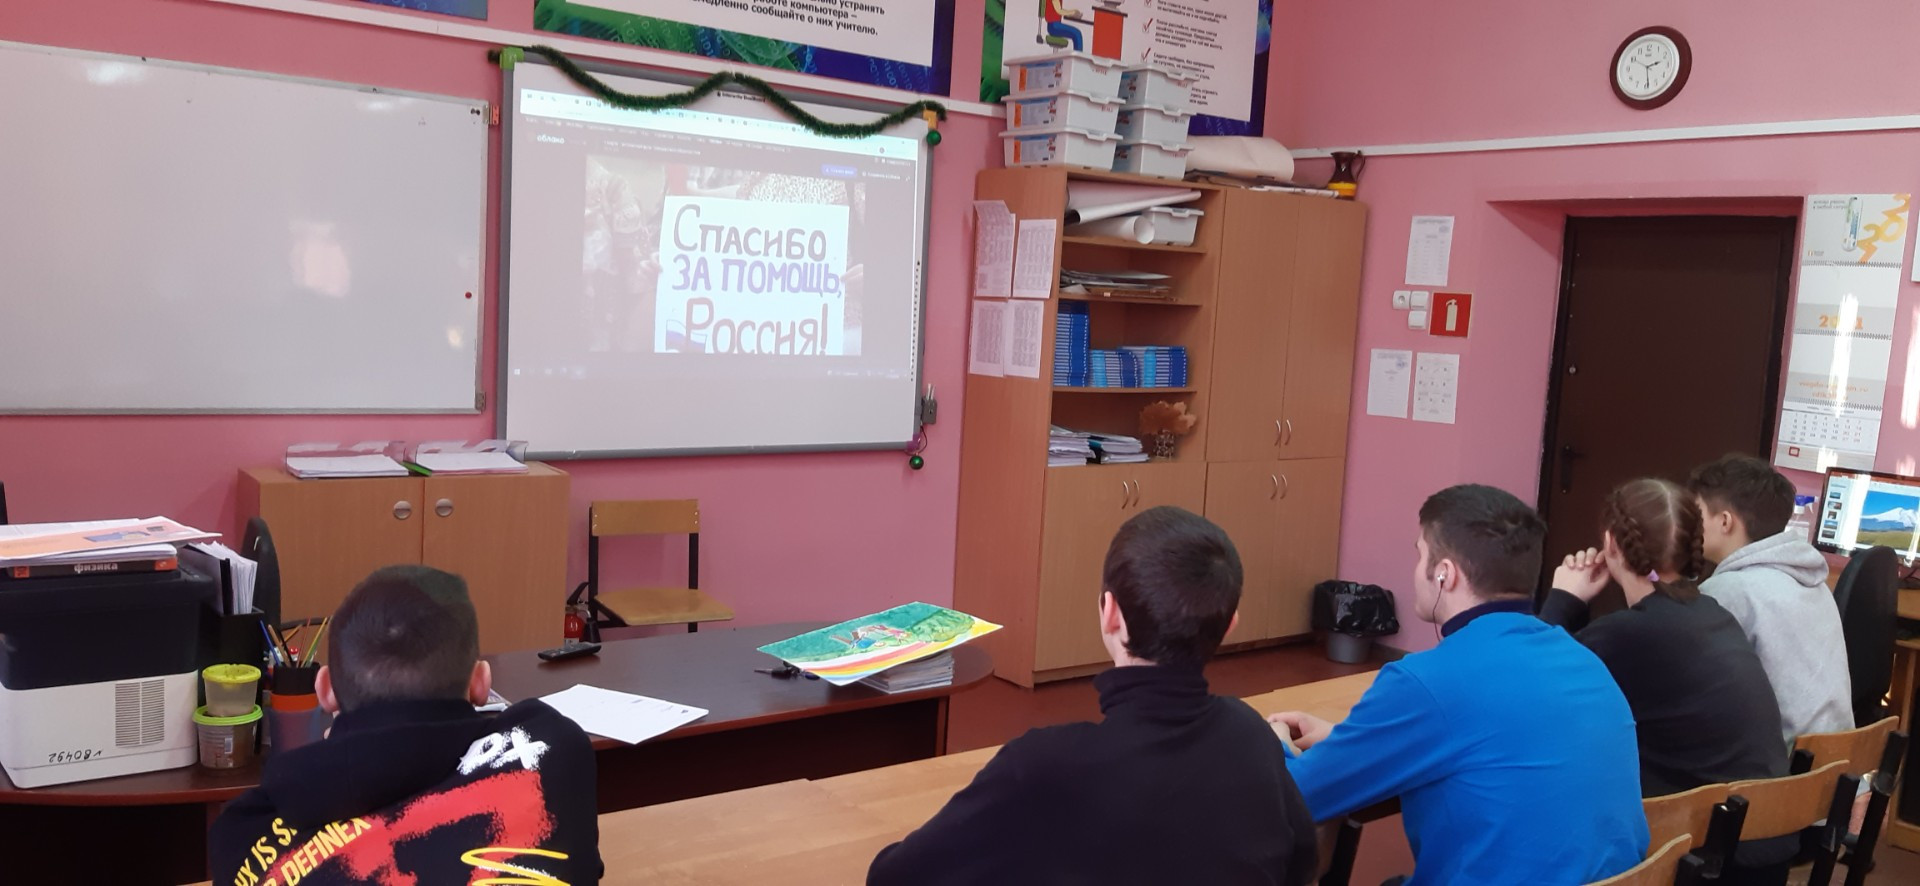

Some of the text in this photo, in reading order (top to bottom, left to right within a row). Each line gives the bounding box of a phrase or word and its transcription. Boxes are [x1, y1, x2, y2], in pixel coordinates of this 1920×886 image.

[790, 1, 849, 19] компьютера
[840, 0, 885, 15] устранять
[751, 5, 805, 22] сообщайте
[807, 15, 814, 23] о
[816, 17, 833, 27] них
[836, 21, 878, 36] учителю.
[536, 133, 566, 145] облако
[672, 253, 842, 299] ЗА ПОМОЩЬ,
[74, 562, 119, 575] физика
[251, 836, 278, 872] IS
